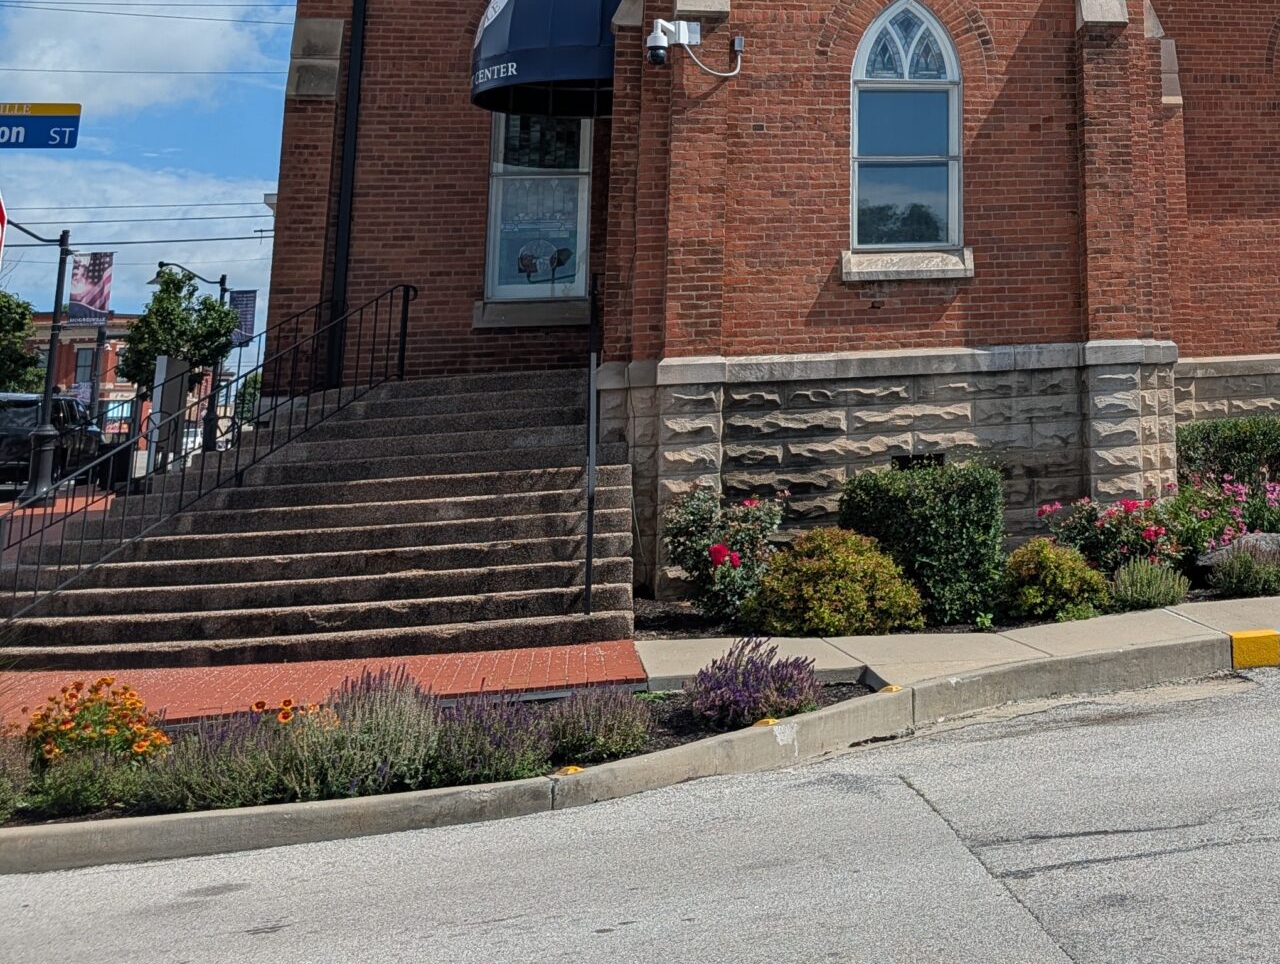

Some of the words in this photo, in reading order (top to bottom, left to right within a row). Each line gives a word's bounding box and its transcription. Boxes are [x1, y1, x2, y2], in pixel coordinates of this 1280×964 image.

[475, 62, 518, 84] CENTER
[0, 126, 25, 143] on
[48, 127, 75, 145] ST
